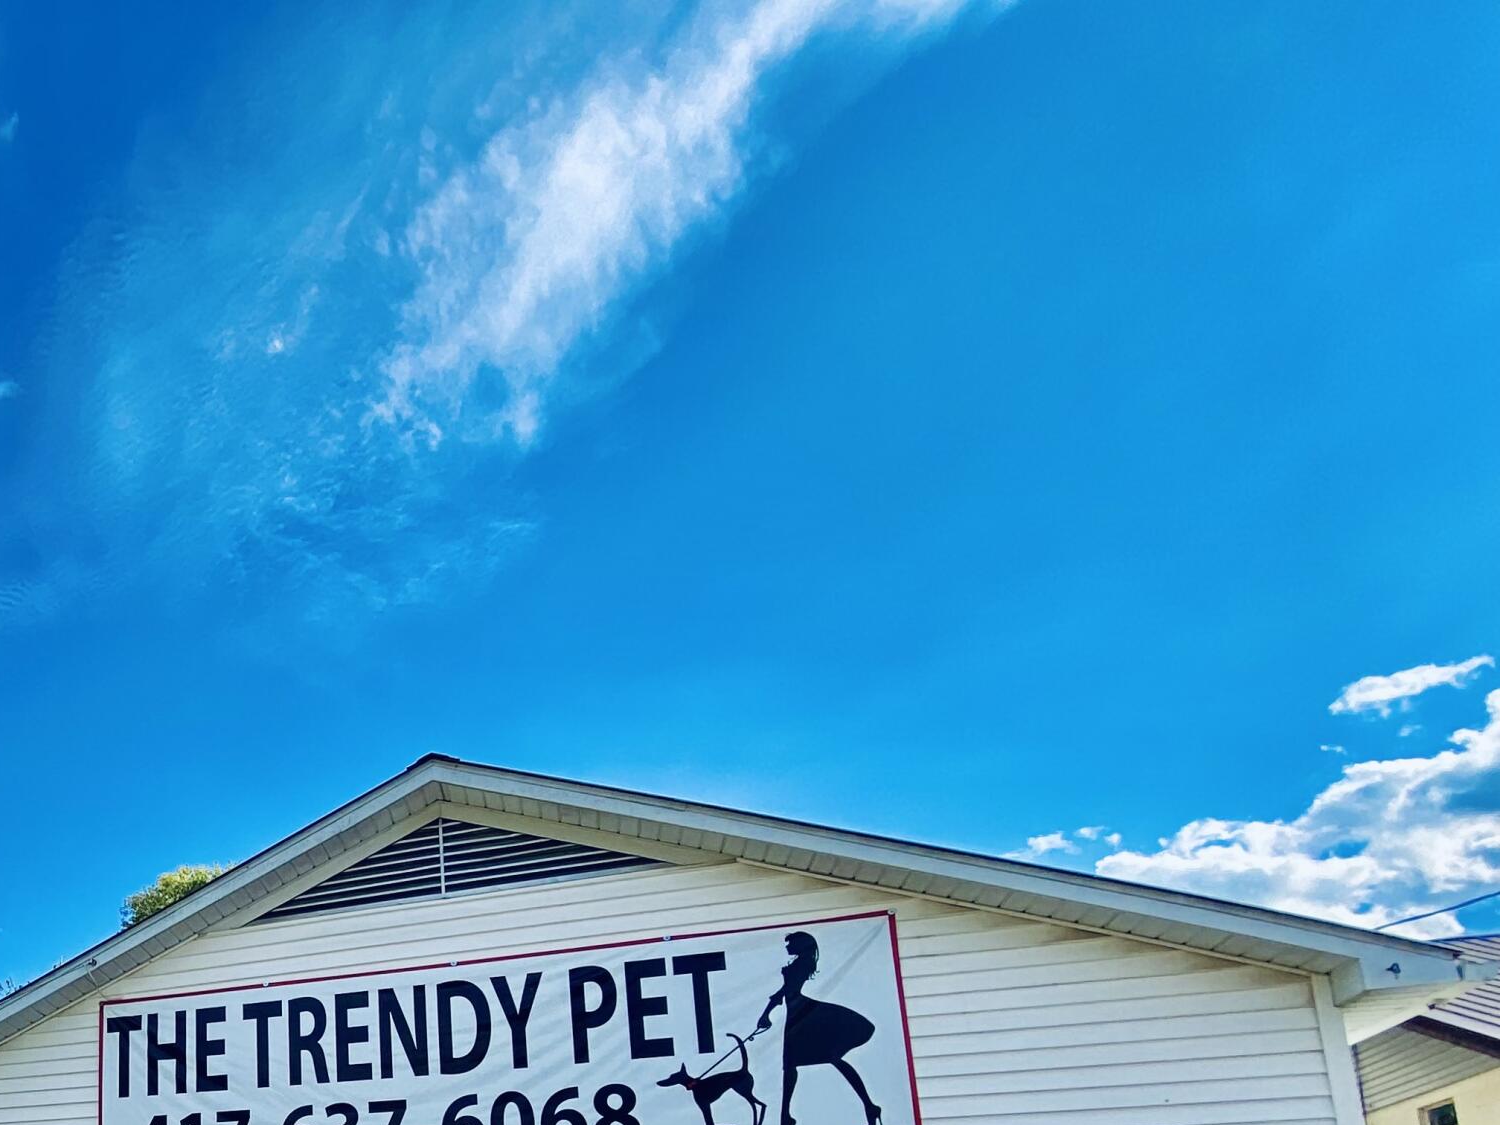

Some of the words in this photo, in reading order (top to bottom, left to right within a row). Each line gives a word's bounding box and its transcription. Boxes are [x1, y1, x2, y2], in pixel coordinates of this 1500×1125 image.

[107, 1006, 228, 1098] THE
[243, 972, 542, 1088] TRENDY
[569, 951, 726, 1064] PET
